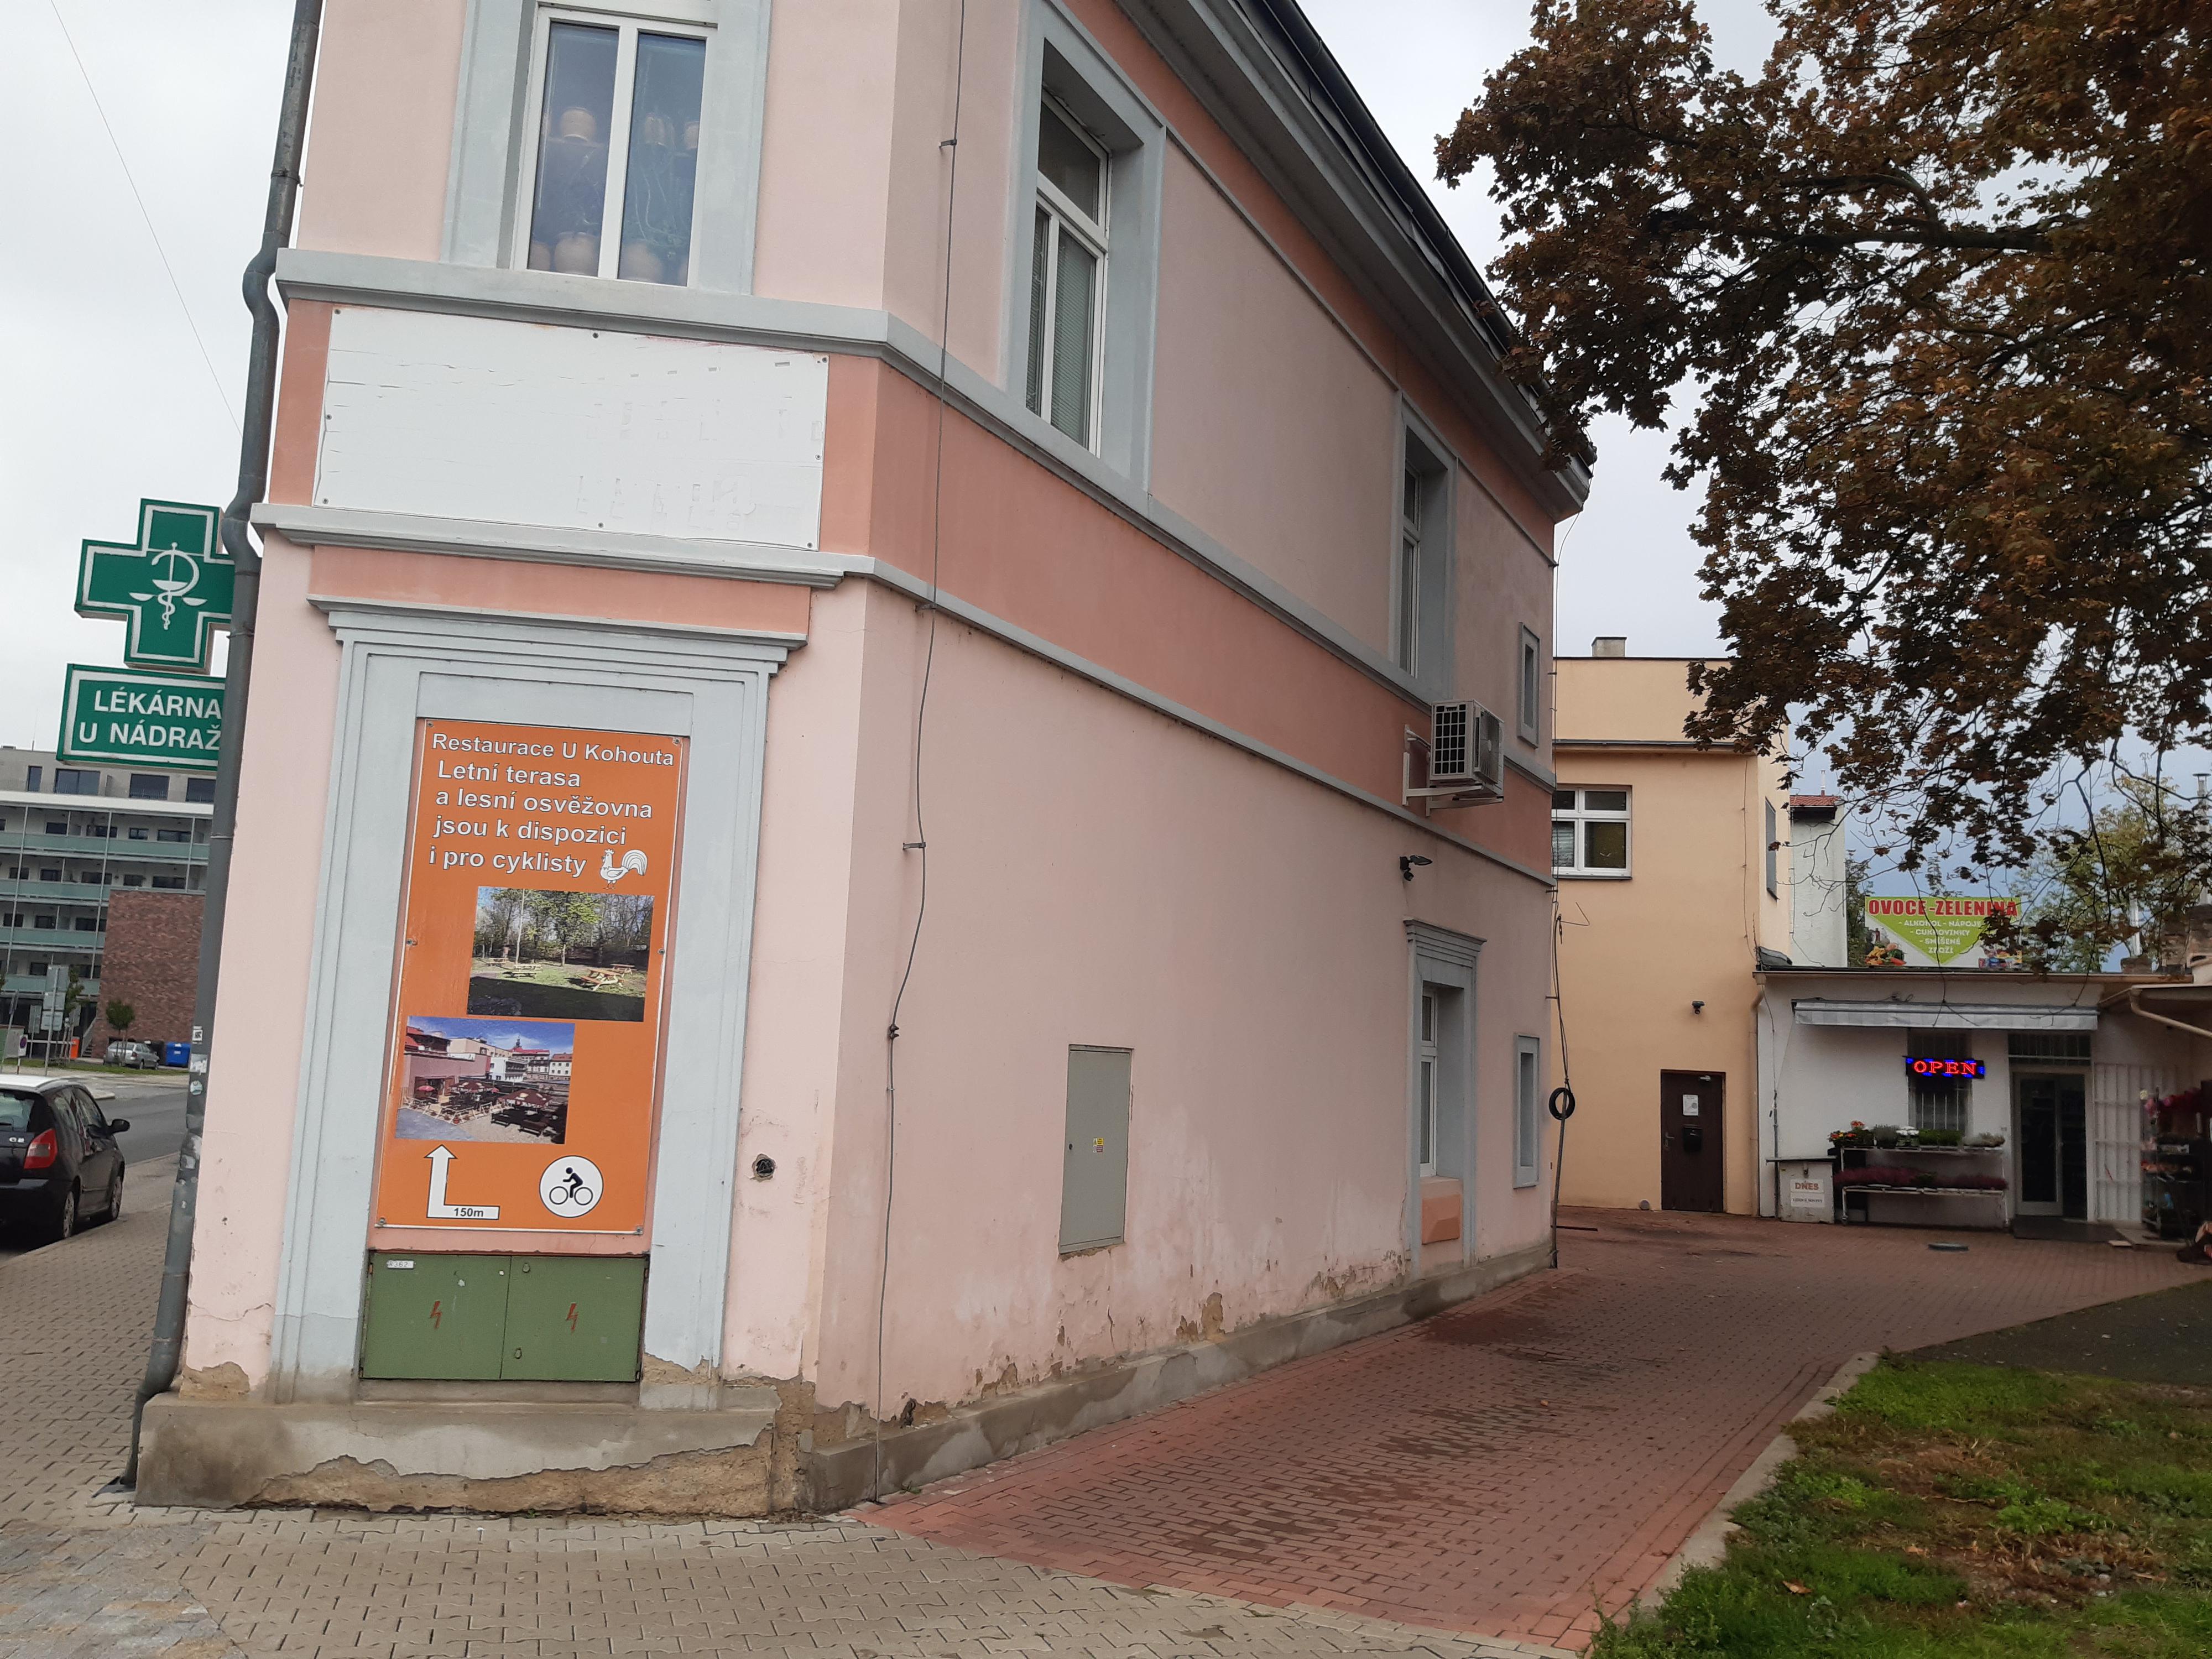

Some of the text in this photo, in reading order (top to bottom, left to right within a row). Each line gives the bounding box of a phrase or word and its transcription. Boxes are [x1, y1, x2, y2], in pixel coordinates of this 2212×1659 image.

[94, 686, 222, 719] LÉKÁRNA
[79, 722, 97, 743] U
[432, 732, 674, 766] Restaurace U Kohouta
[438, 760, 581, 787] Letní terasa
[436, 787, 653, 818] a lesní osvěžovna
[433, 815, 626, 846] jsou k dispozici
[429, 846, 586, 878] i pro cyklisty
[1914, 1061, 1977, 1075] OPEN
[454, 1207, 484, 1217] 150m
